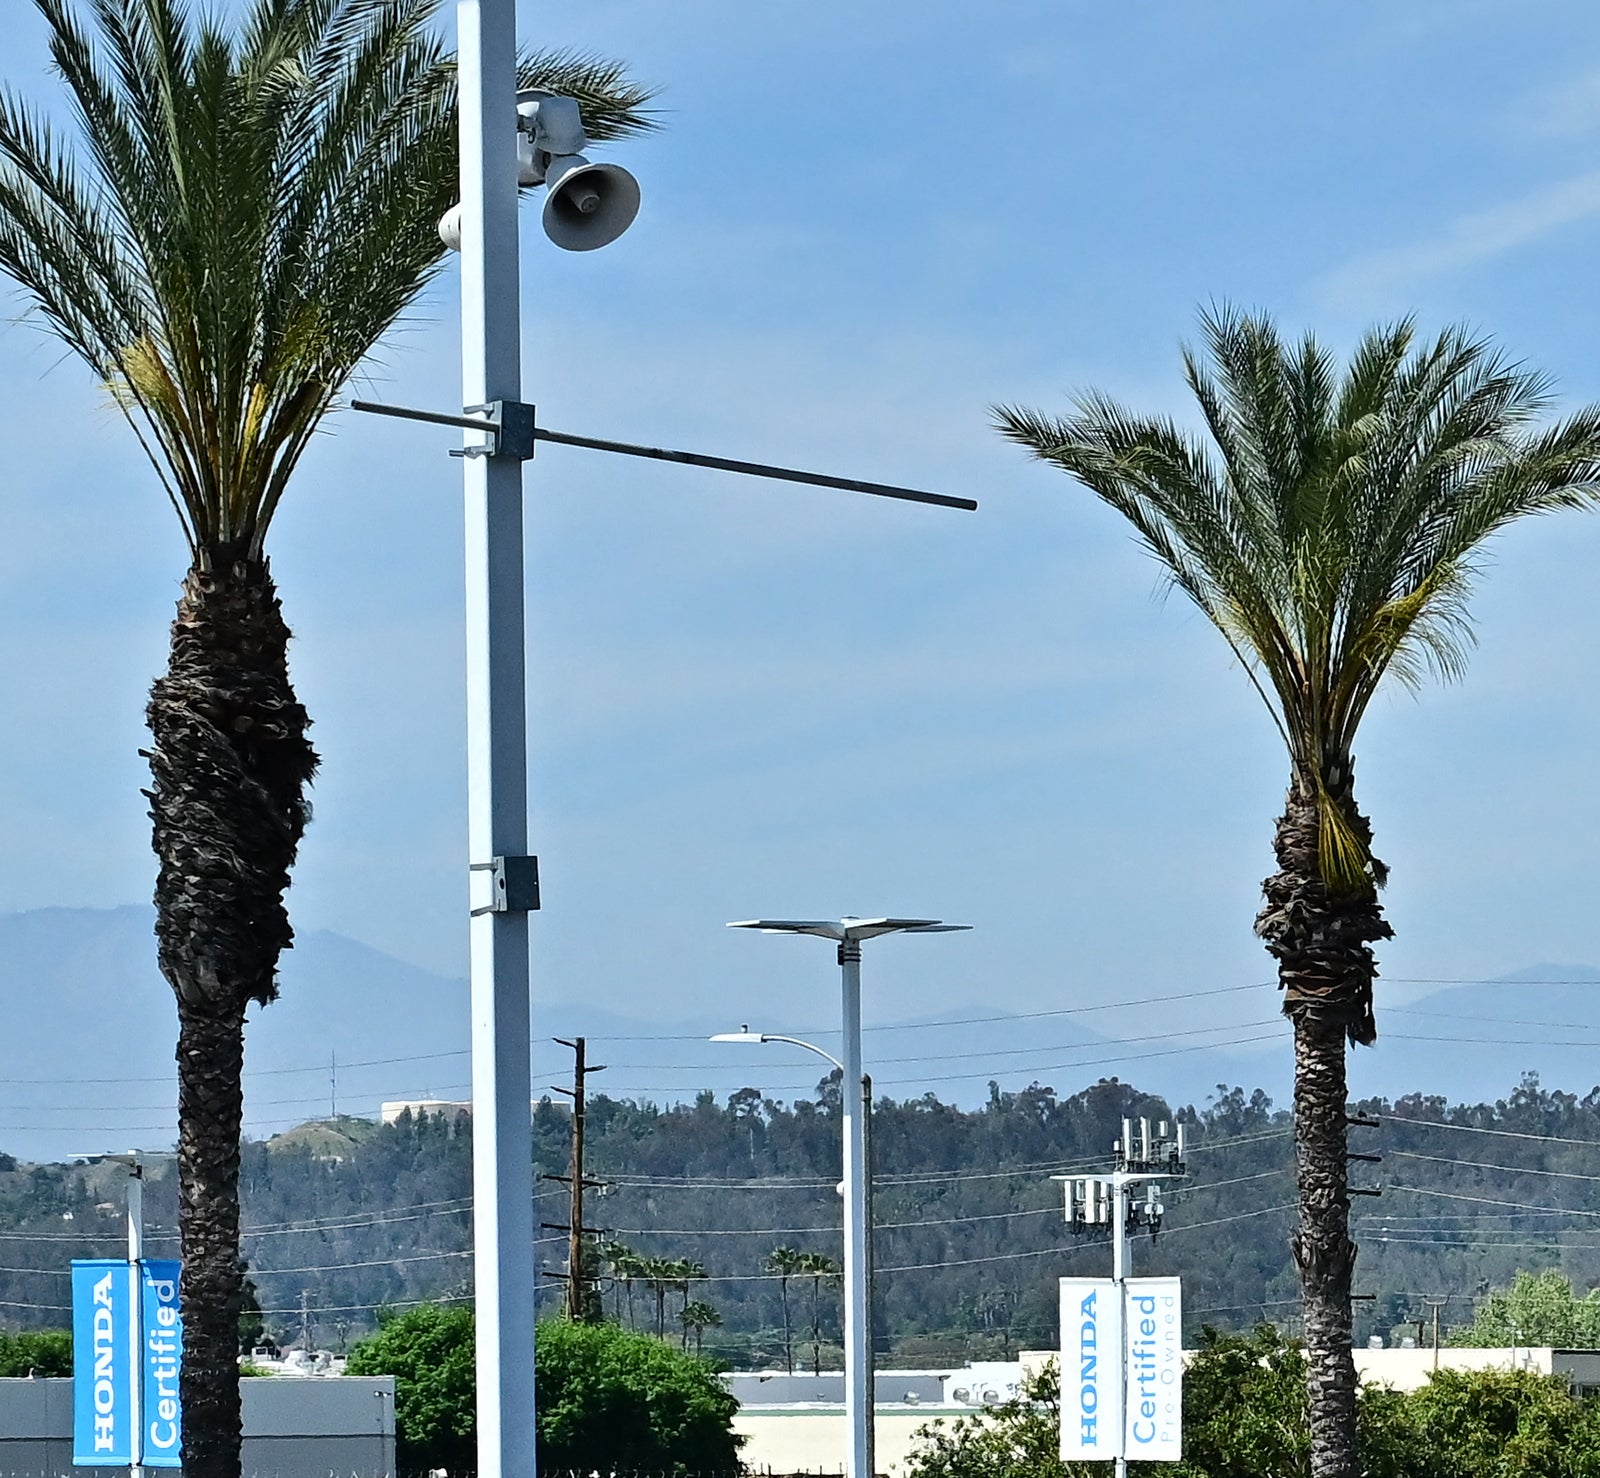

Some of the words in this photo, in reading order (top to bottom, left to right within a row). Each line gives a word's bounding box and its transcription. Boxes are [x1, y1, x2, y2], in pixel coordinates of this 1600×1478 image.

[93, 1270, 114, 1453] HONDA
[147, 1279, 177, 1449] Certified
[1080, 1288, 1098, 1447] HONDA
[1131, 1295, 1156, 1444] Certified
[1160, 1296, 1175, 1443] Pre-Owned
